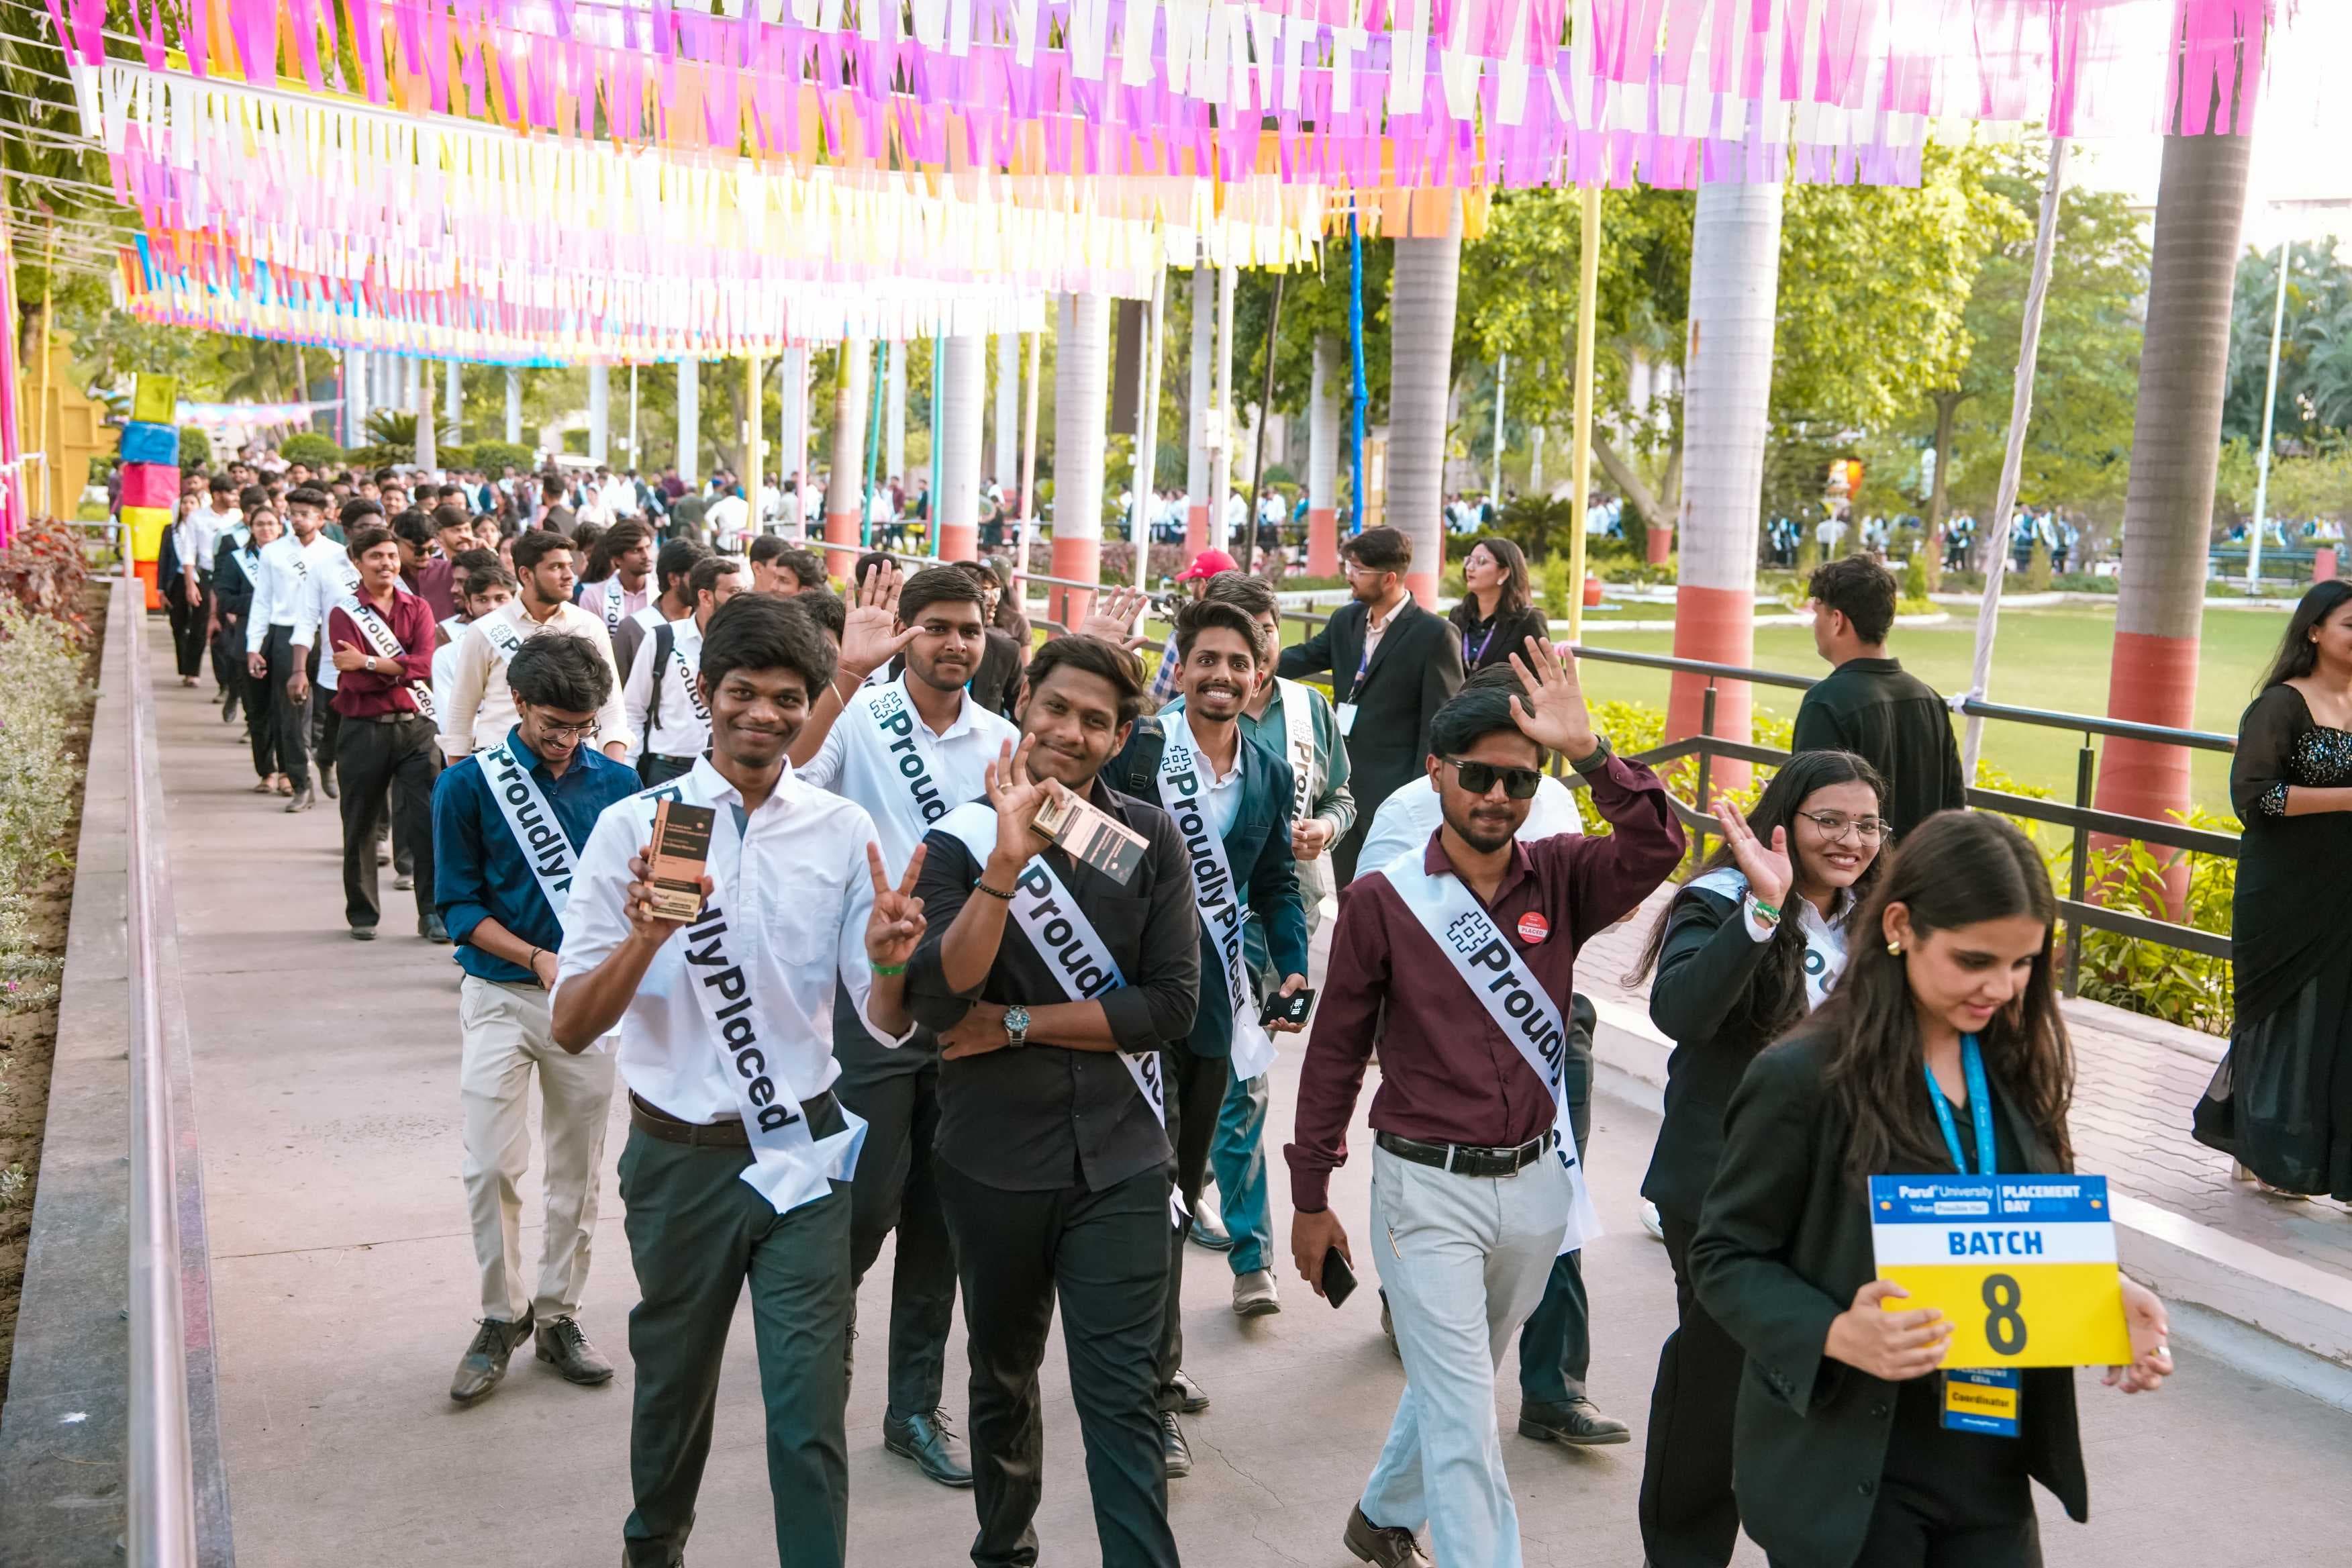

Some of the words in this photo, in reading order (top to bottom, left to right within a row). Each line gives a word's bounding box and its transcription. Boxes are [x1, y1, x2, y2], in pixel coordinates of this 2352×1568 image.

[869, 691, 955, 826] #Proud
[648, 820, 664, 869] PUPlacement
[1162, 745, 1245, 1018] #ProudlyPlaced
[1521, 927, 1544, 935] PLACED
[1898, 1185, 1933, 1199] Parul
[1939, 1185, 1994, 1199] University
[2002, 1185, 2081, 1199] PLACEMENT
[2004, 1200, 2030, 1213] DAY
[1948, 1230, 2043, 1255] BATCH
[1981, 1273, 2028, 1356] 8
[1951, 1391, 2010, 1408] Coordinator
